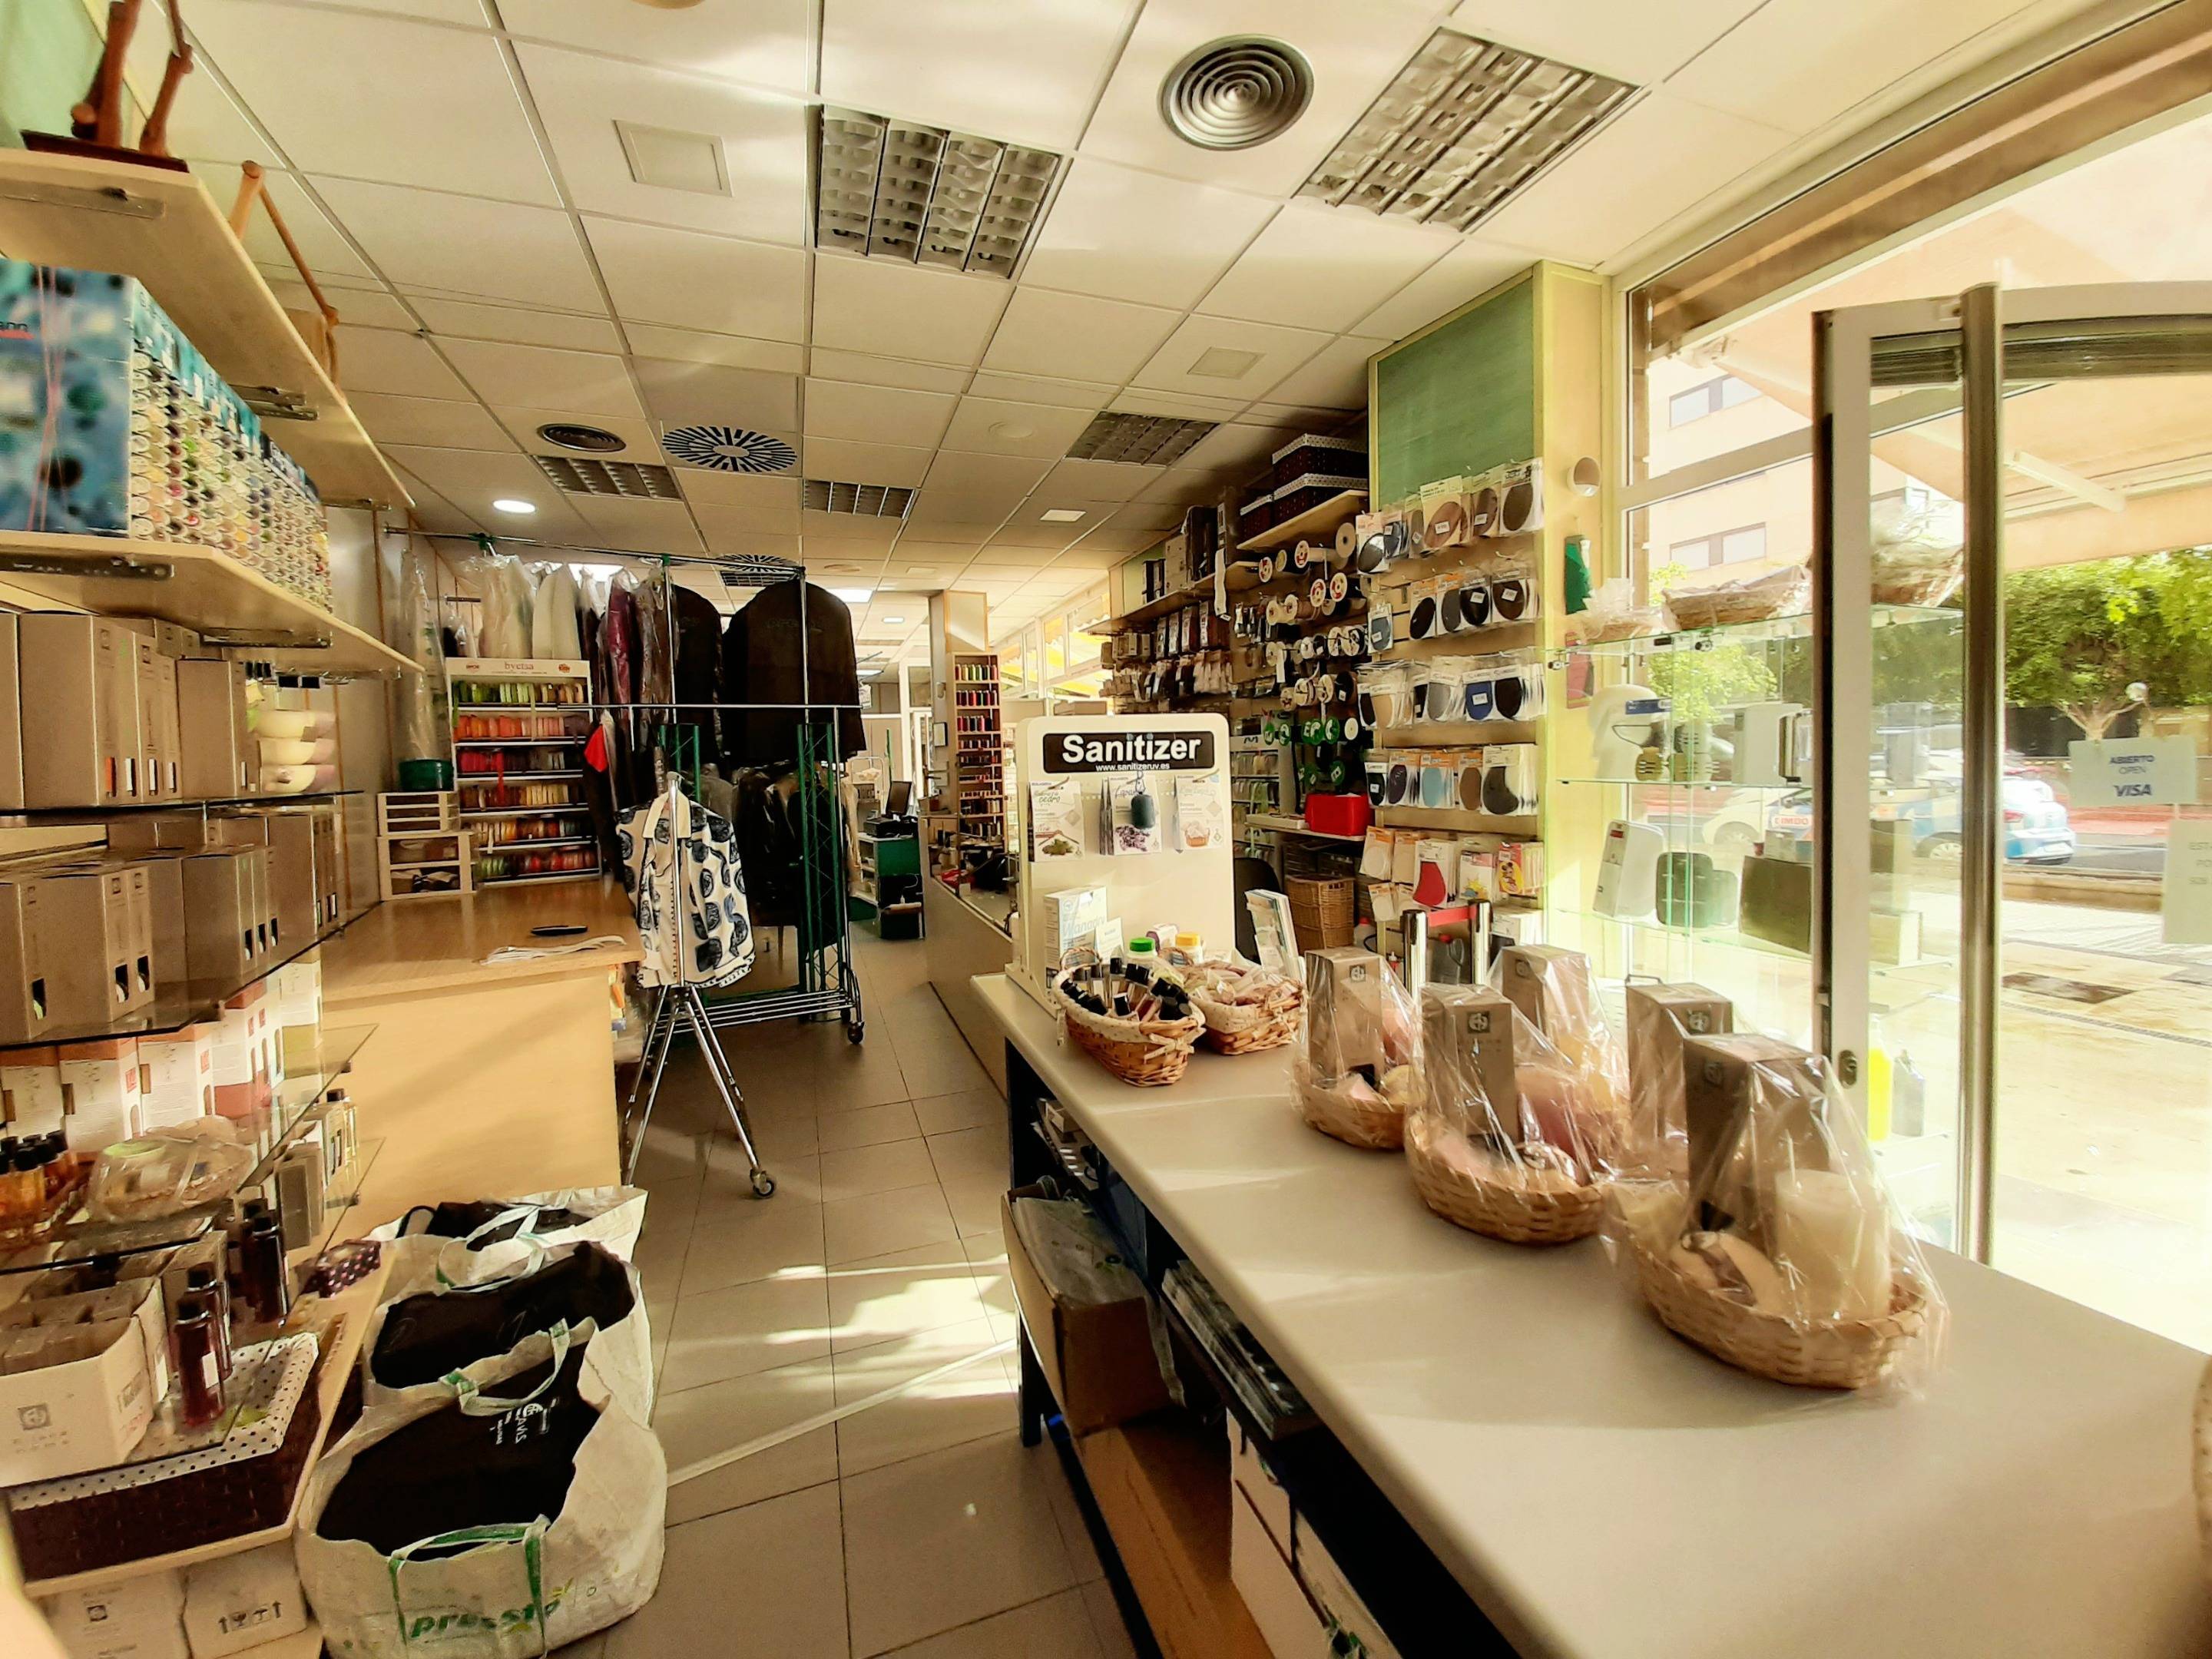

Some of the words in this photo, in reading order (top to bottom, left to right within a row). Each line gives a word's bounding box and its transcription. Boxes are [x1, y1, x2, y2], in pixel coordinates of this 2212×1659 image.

[1062, 732, 1202, 763] Sanitizer
[2109, 755, 2155, 764] ABIERTO
[1095, 763, 1171, 772] www.sanitizeruv.es
[2119, 766, 2147, 774] OPEN
[2113, 783, 2152, 797] VISA
